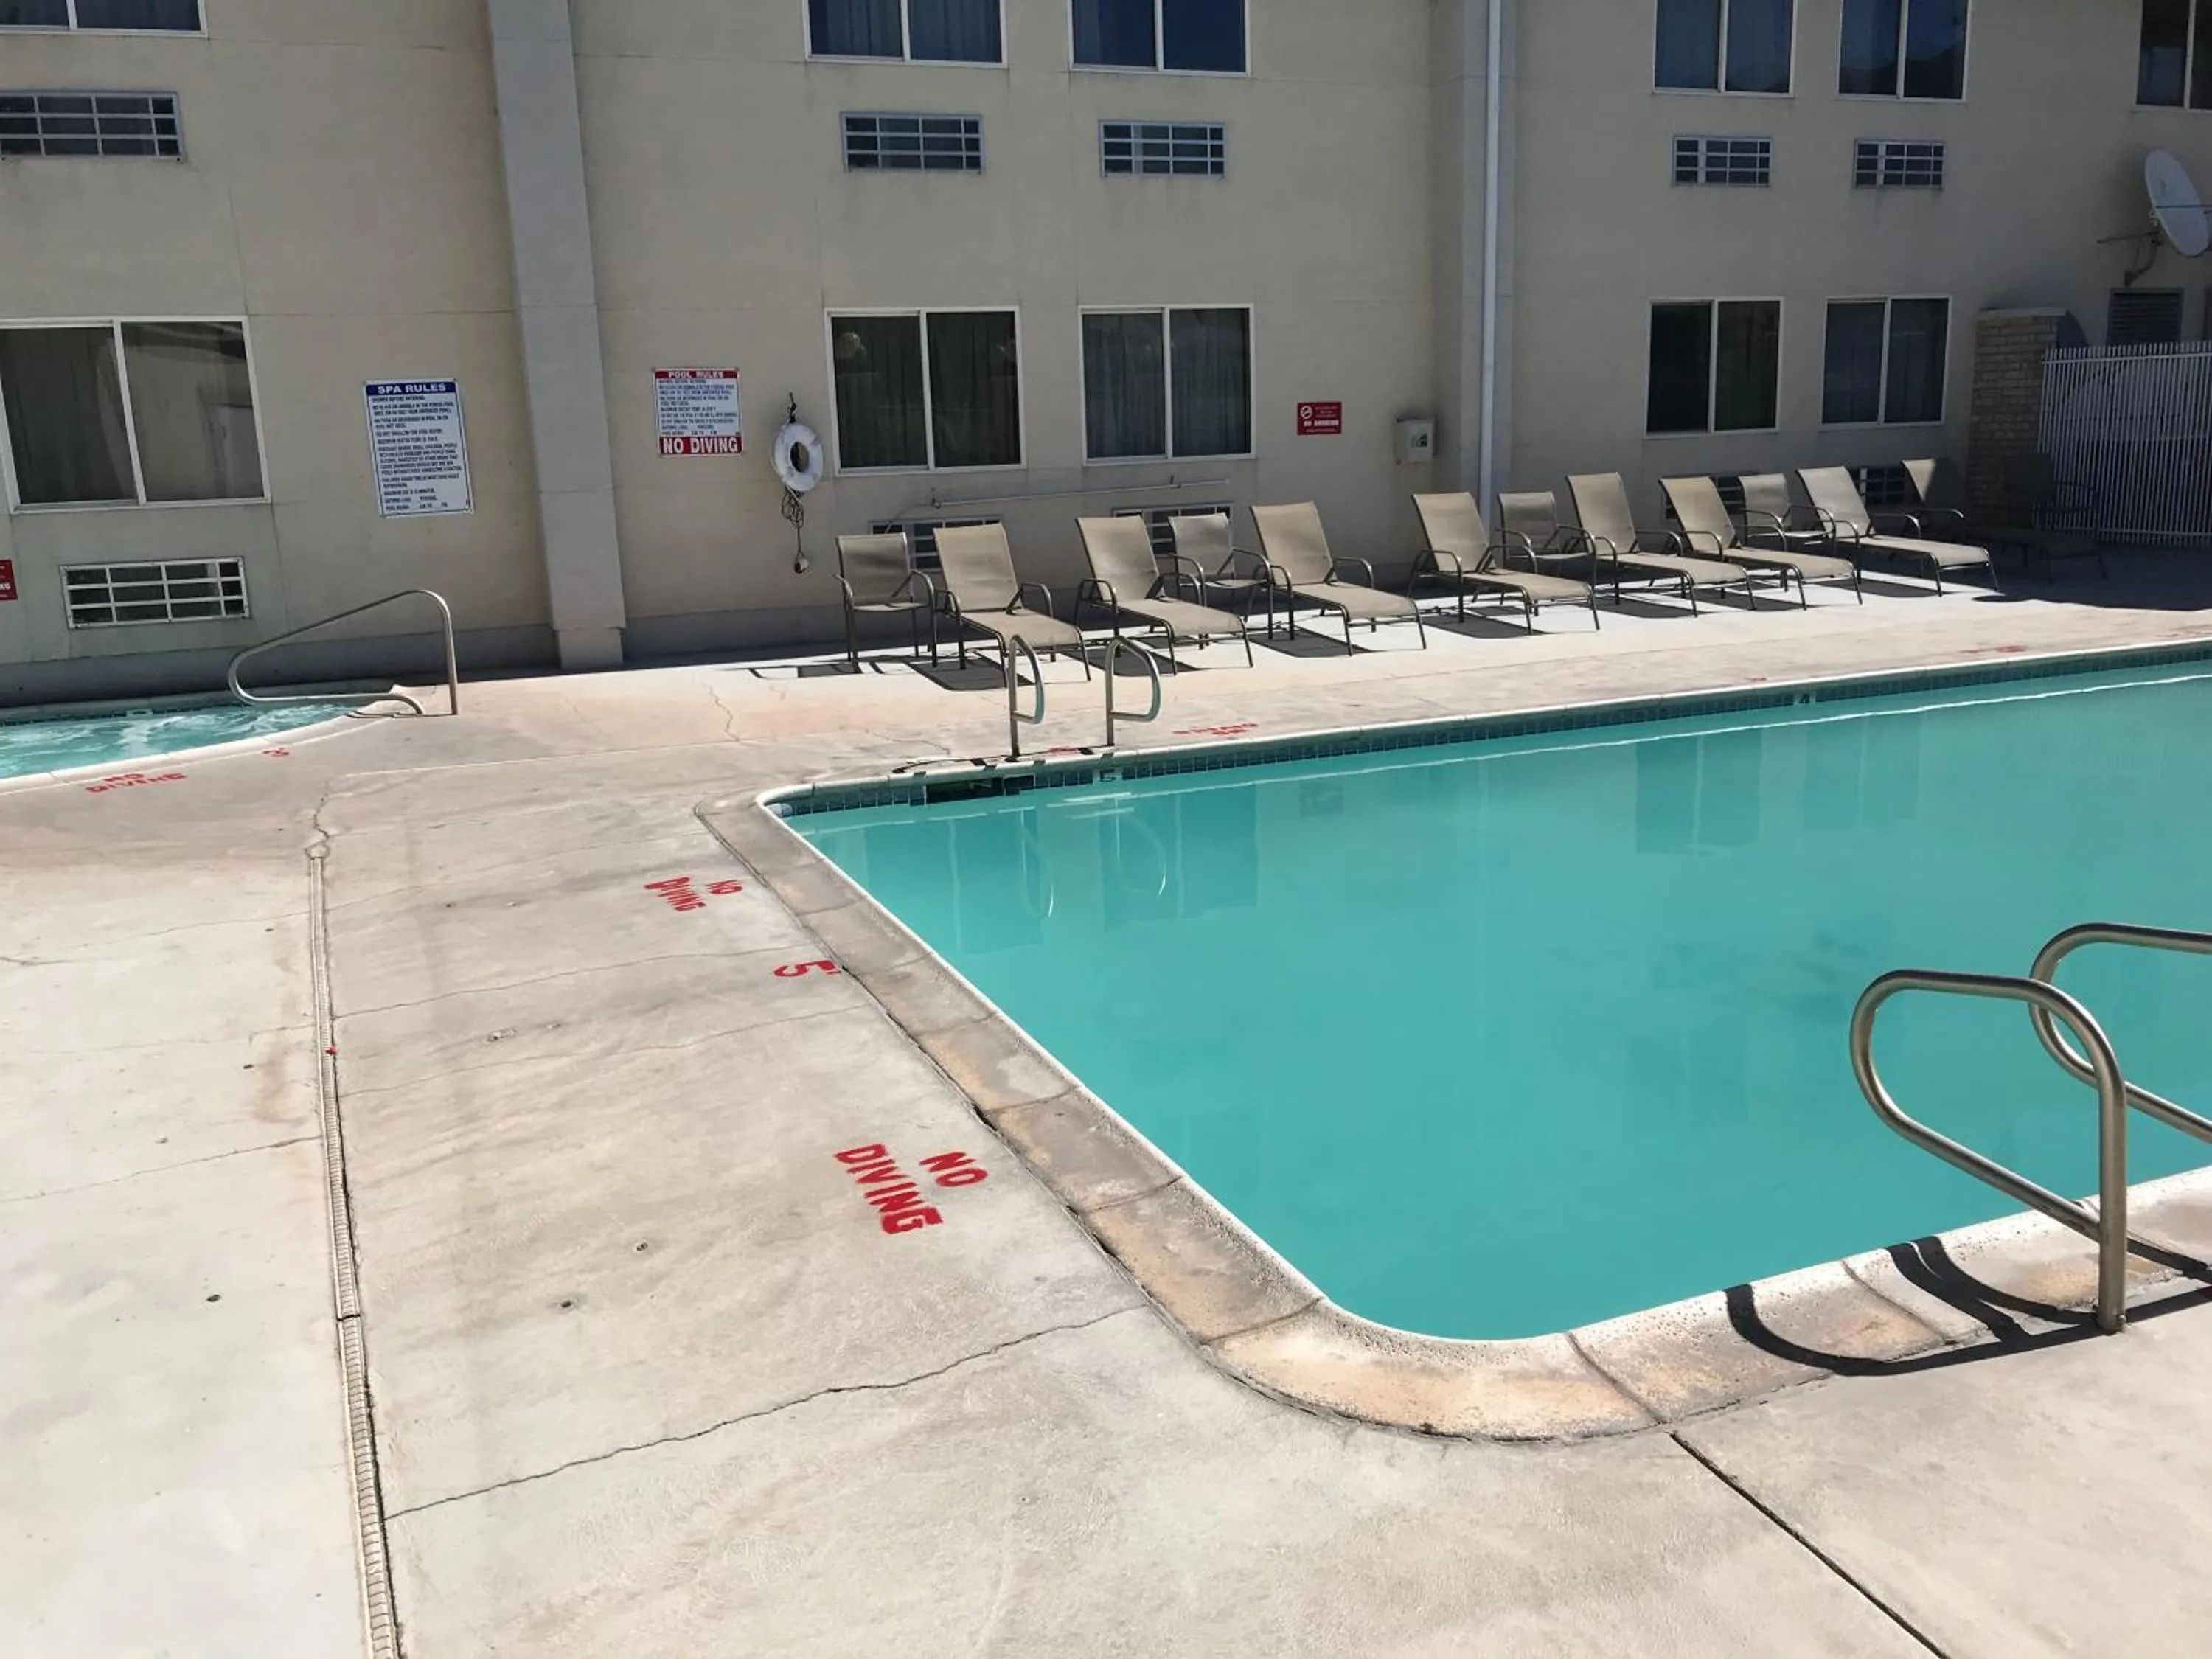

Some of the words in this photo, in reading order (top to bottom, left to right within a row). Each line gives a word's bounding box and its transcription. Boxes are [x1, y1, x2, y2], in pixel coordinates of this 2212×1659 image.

[378, 386, 402, 394] SPA
[406, 383, 446, 392] RULES
[663, 438, 684, 453] NO
[690, 437, 738, 453] DIVING
[705, 880, 743, 895] NO
[919, 1151, 989, 1186] NO
[834, 1144, 944, 1234] DIVING
